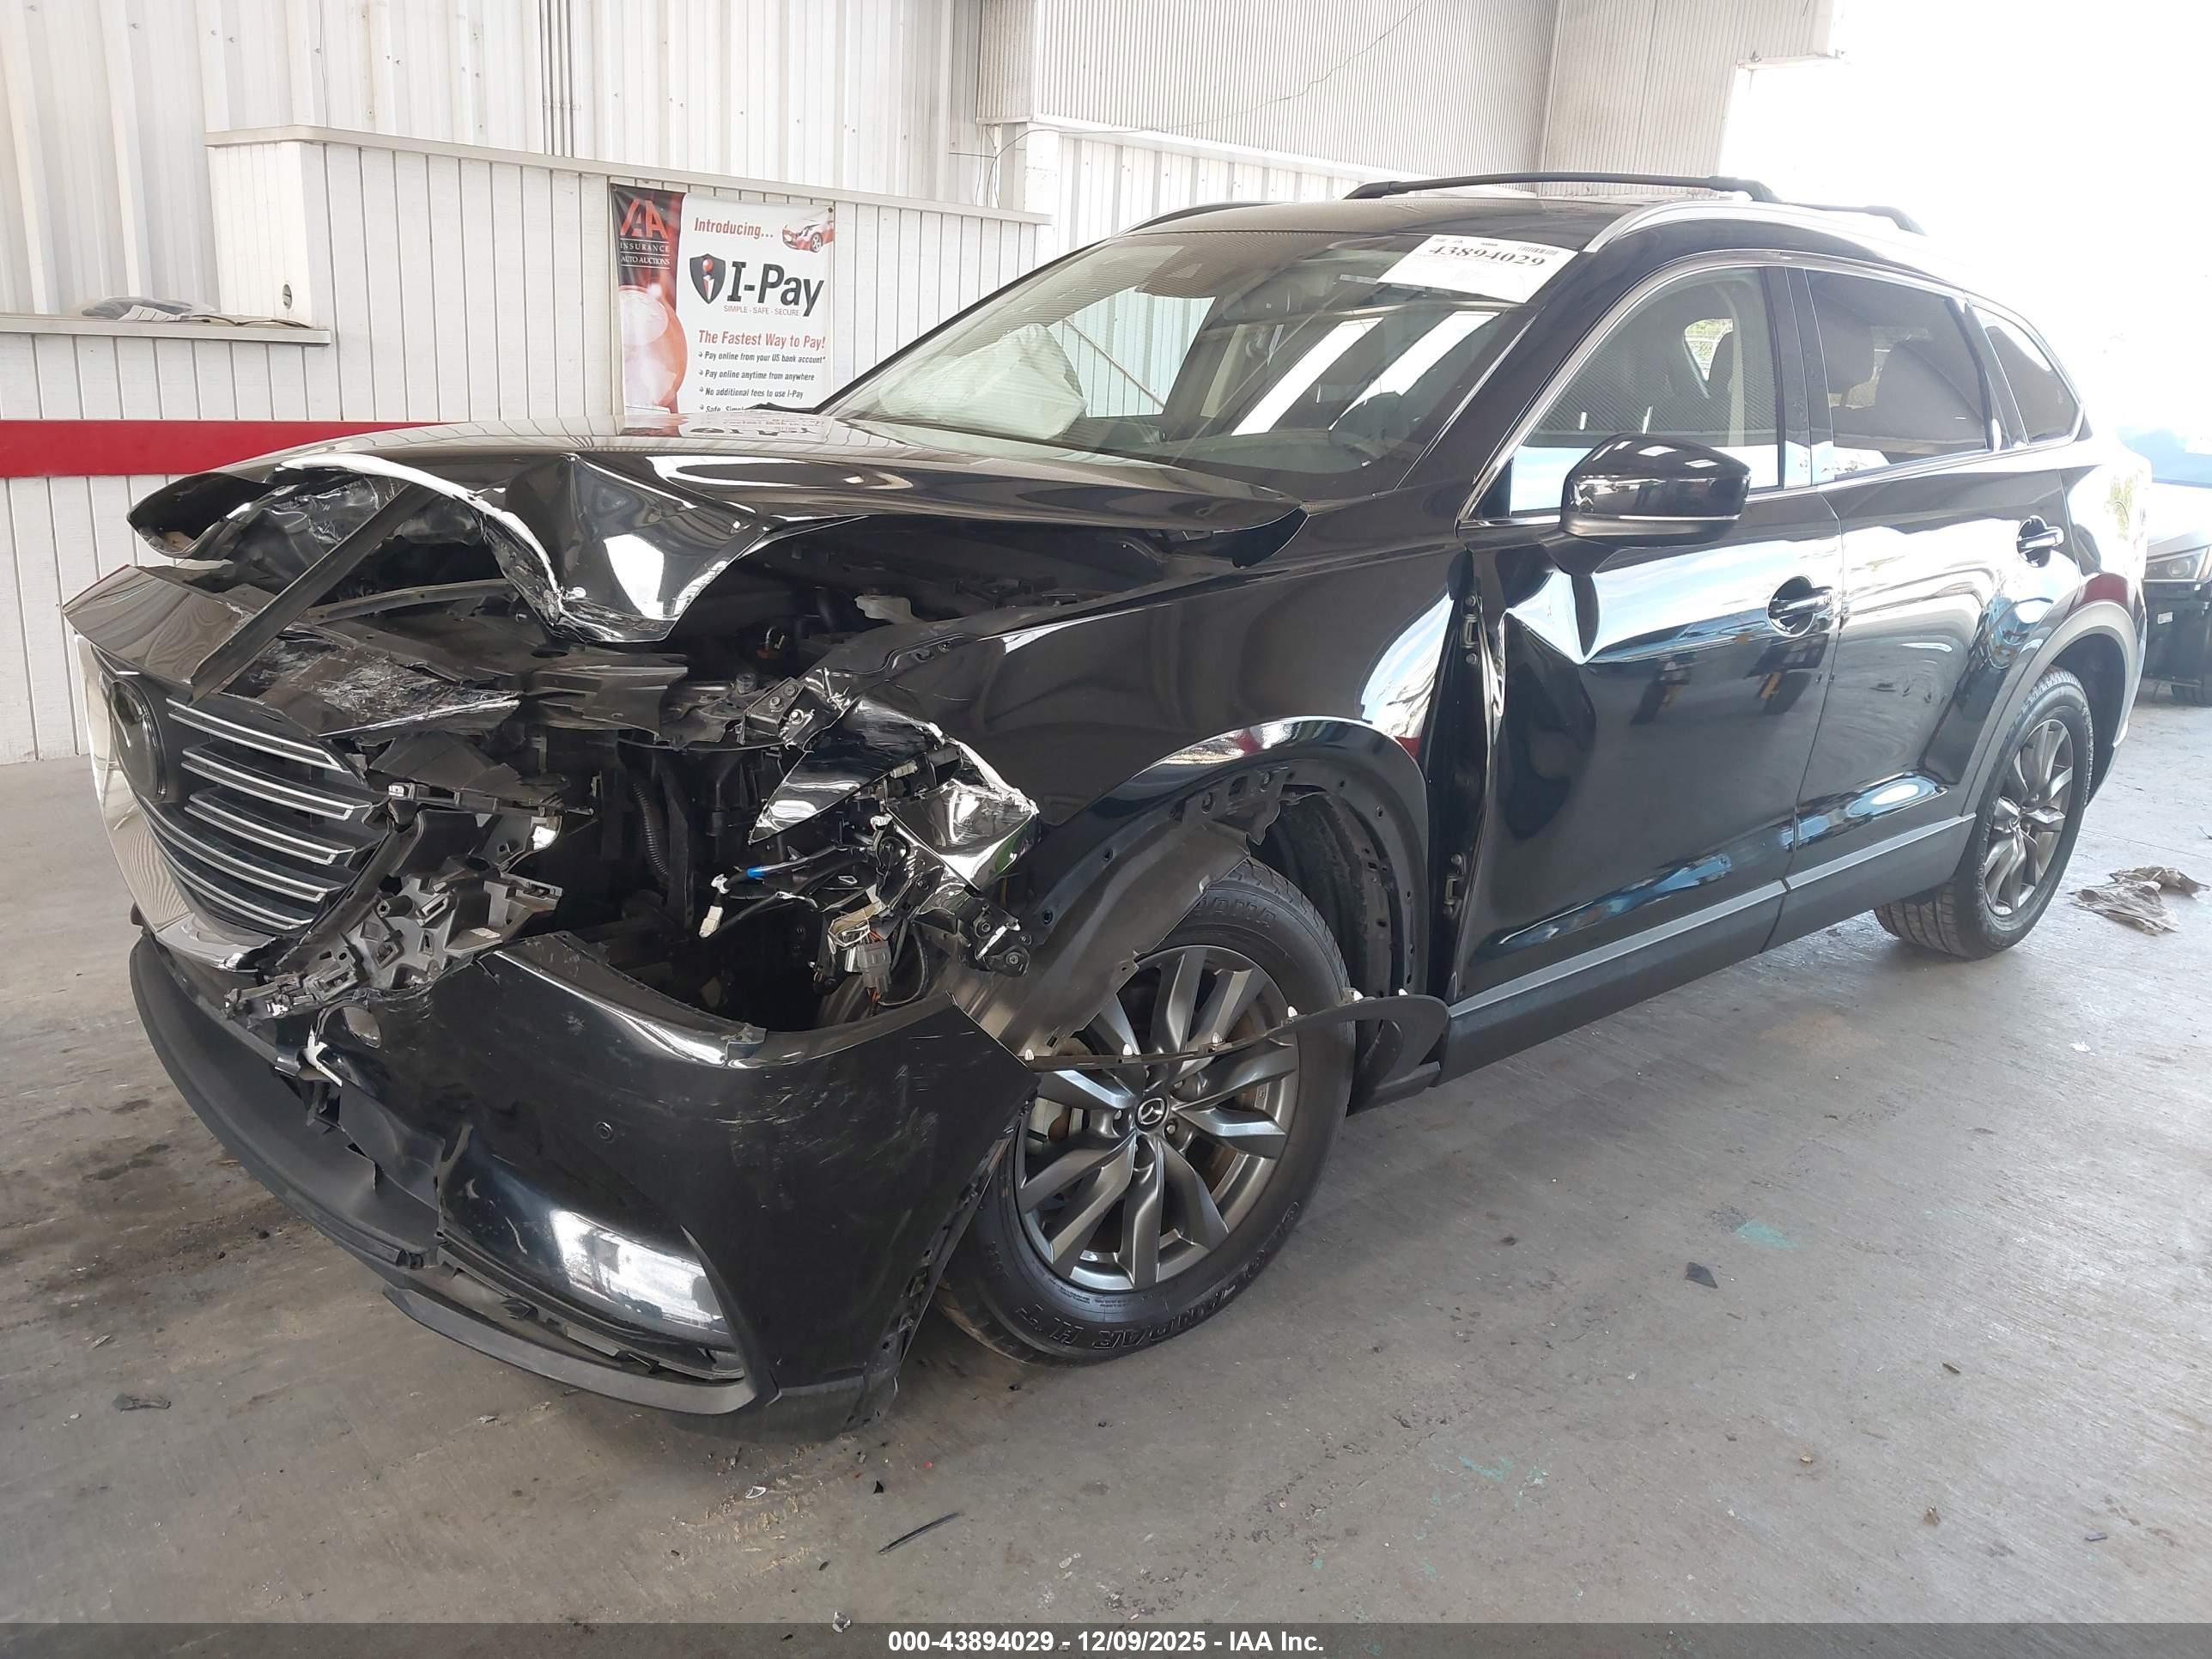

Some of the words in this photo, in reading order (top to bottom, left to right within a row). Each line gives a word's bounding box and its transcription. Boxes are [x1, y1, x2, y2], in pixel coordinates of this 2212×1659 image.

[694, 217, 774, 240] Introducing...
[620, 242, 670, 252] INSURANCE
[639, 257, 671, 265] AUCTIONS
[1429, 245, 1547, 266] 43894029
[727, 261, 825, 317] I-Pay
[724, 305, 748, 313] SIMPLE
[775, 307, 800, 316] SECURE
[699, 330, 718, 343] The
[722, 331, 762, 345] Fastest
[765, 333, 787, 349] Way
[790, 335, 799, 347] to
[804, 335, 826, 351] Pay!
[704, 351, 716, 362] Pay
[705, 369, 717, 380] Pay
[741, 371, 767, 380] anytime
[785, 373, 815, 381] anywhere
[705, 387, 714, 396] No
[715, 388, 749, 397] additional
[750, 388, 764, 397] fees
